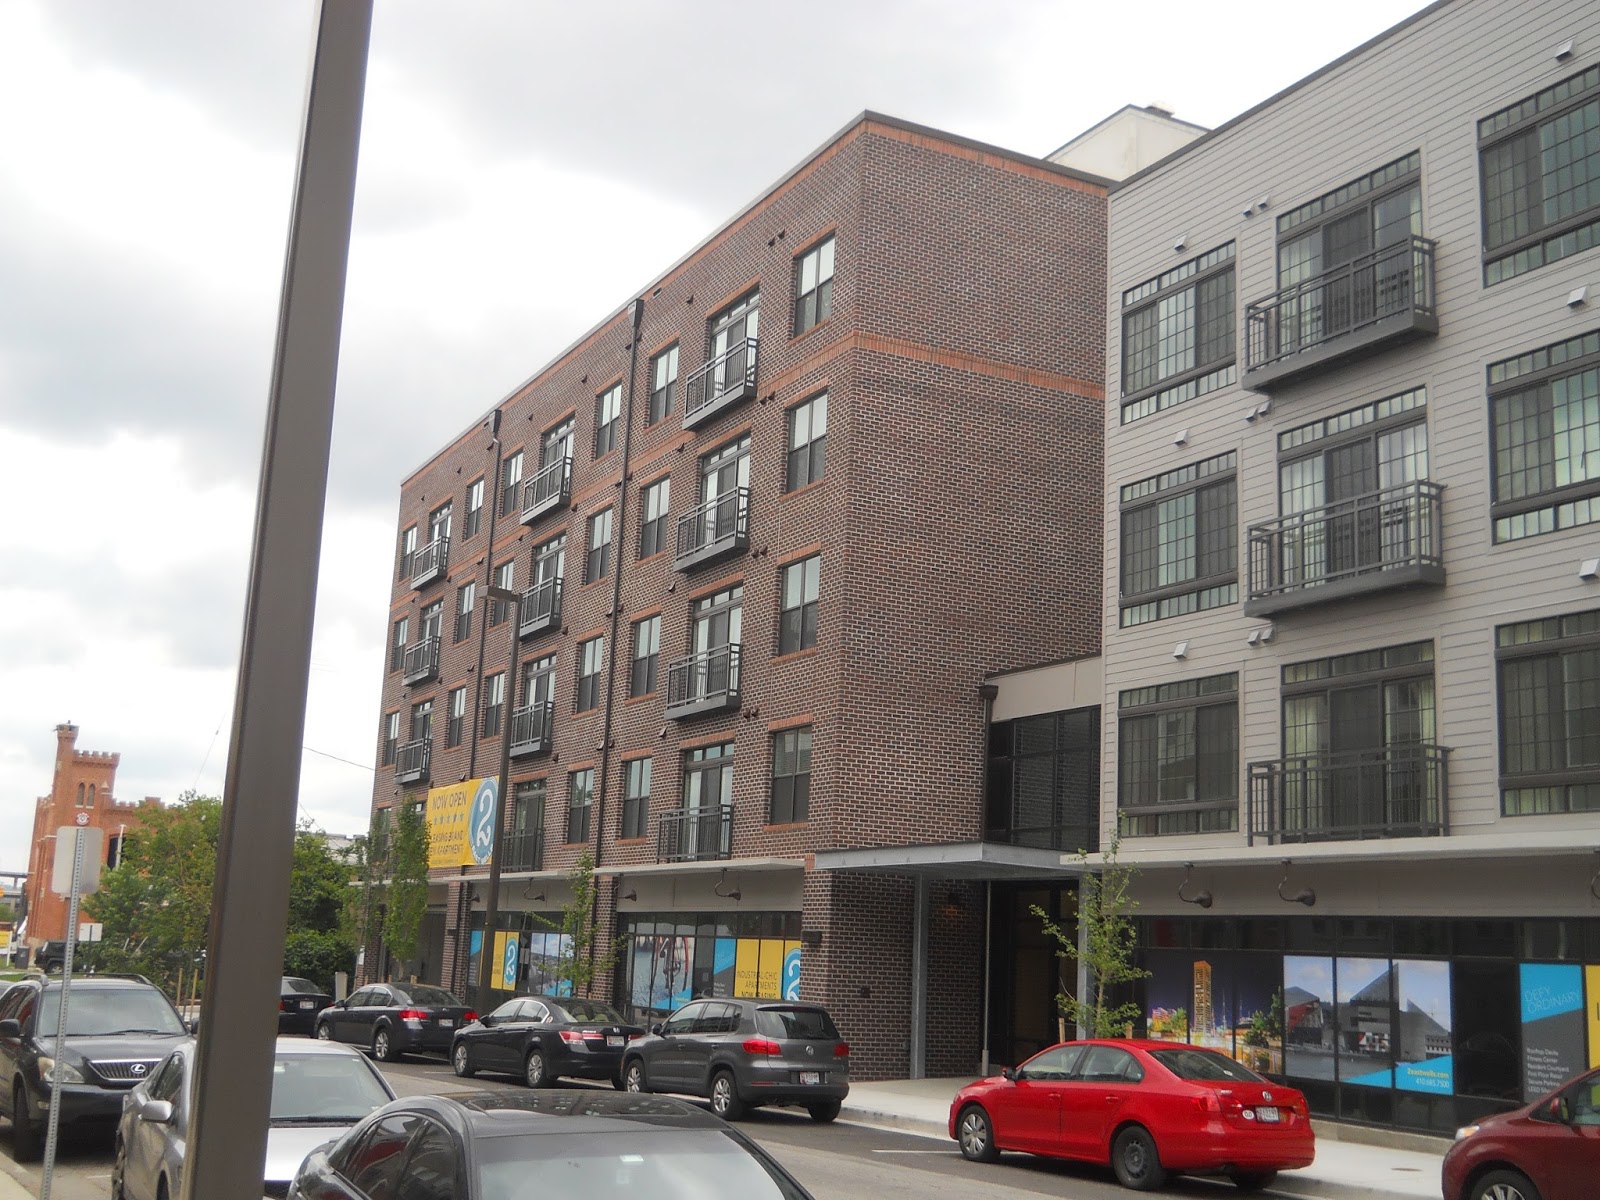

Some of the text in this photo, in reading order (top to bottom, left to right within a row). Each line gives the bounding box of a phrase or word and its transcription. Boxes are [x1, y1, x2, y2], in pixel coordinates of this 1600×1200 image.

[433, 791, 466, 810] NOW OPEN
[431, 832, 449, 842] EASING
[737, 970, 777, 980] NDUSTRAL-CHIC
[745, 980, 777, 990] APARMENTS
[1525, 987, 1550, 1001] DEFY
[1528, 991, 1579, 1013] ORDINARY
